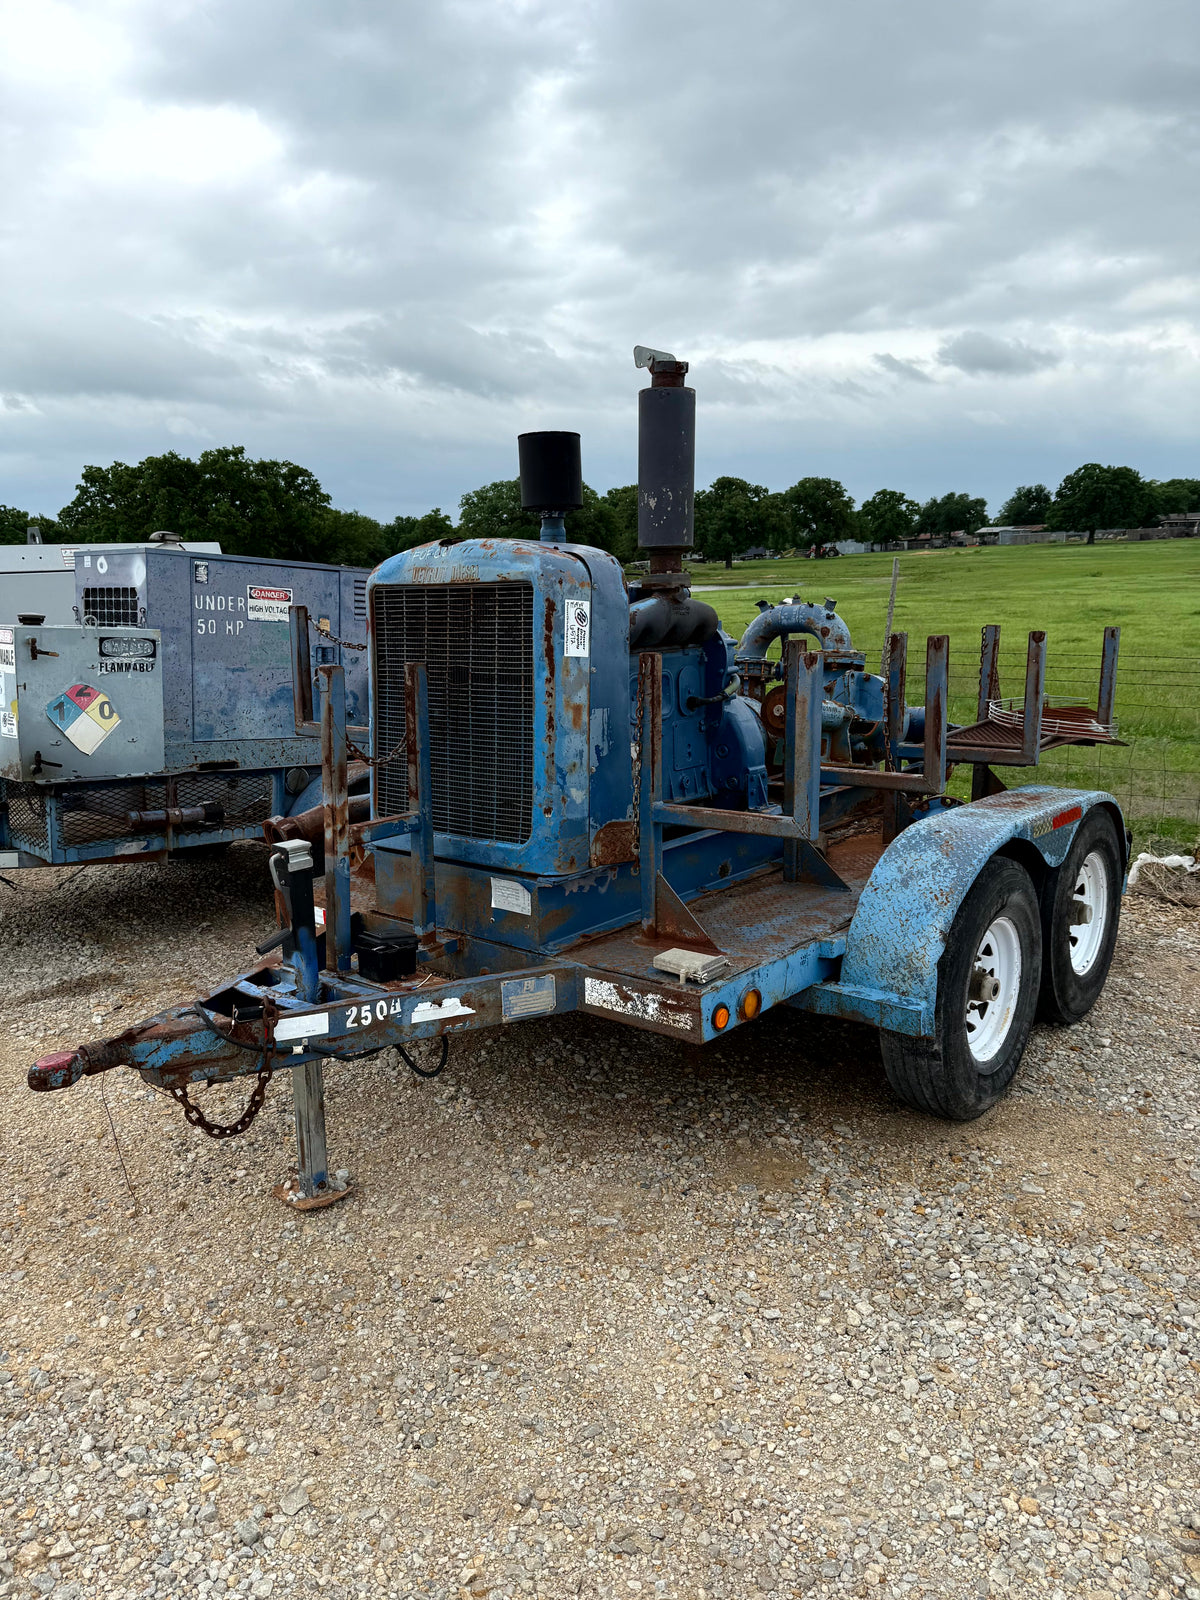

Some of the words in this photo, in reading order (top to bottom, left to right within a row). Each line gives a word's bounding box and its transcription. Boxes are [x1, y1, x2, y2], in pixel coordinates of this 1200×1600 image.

[451, 564, 480, 582] DIESEL
[194, 594, 246, 612] UNDER
[255, 590, 285, 600] DANGER
[249, 605, 264, 613] HIGH
[264, 606, 289, 614] VOLTAG
[197, 618, 217, 635] 50
[225, 620, 244, 636] HP
[75, 684, 91, 697] 2
[53, 701, 65, 721] 1
[98, 700, 114, 720] 0
[345, 997, 402, 1029] 2504
